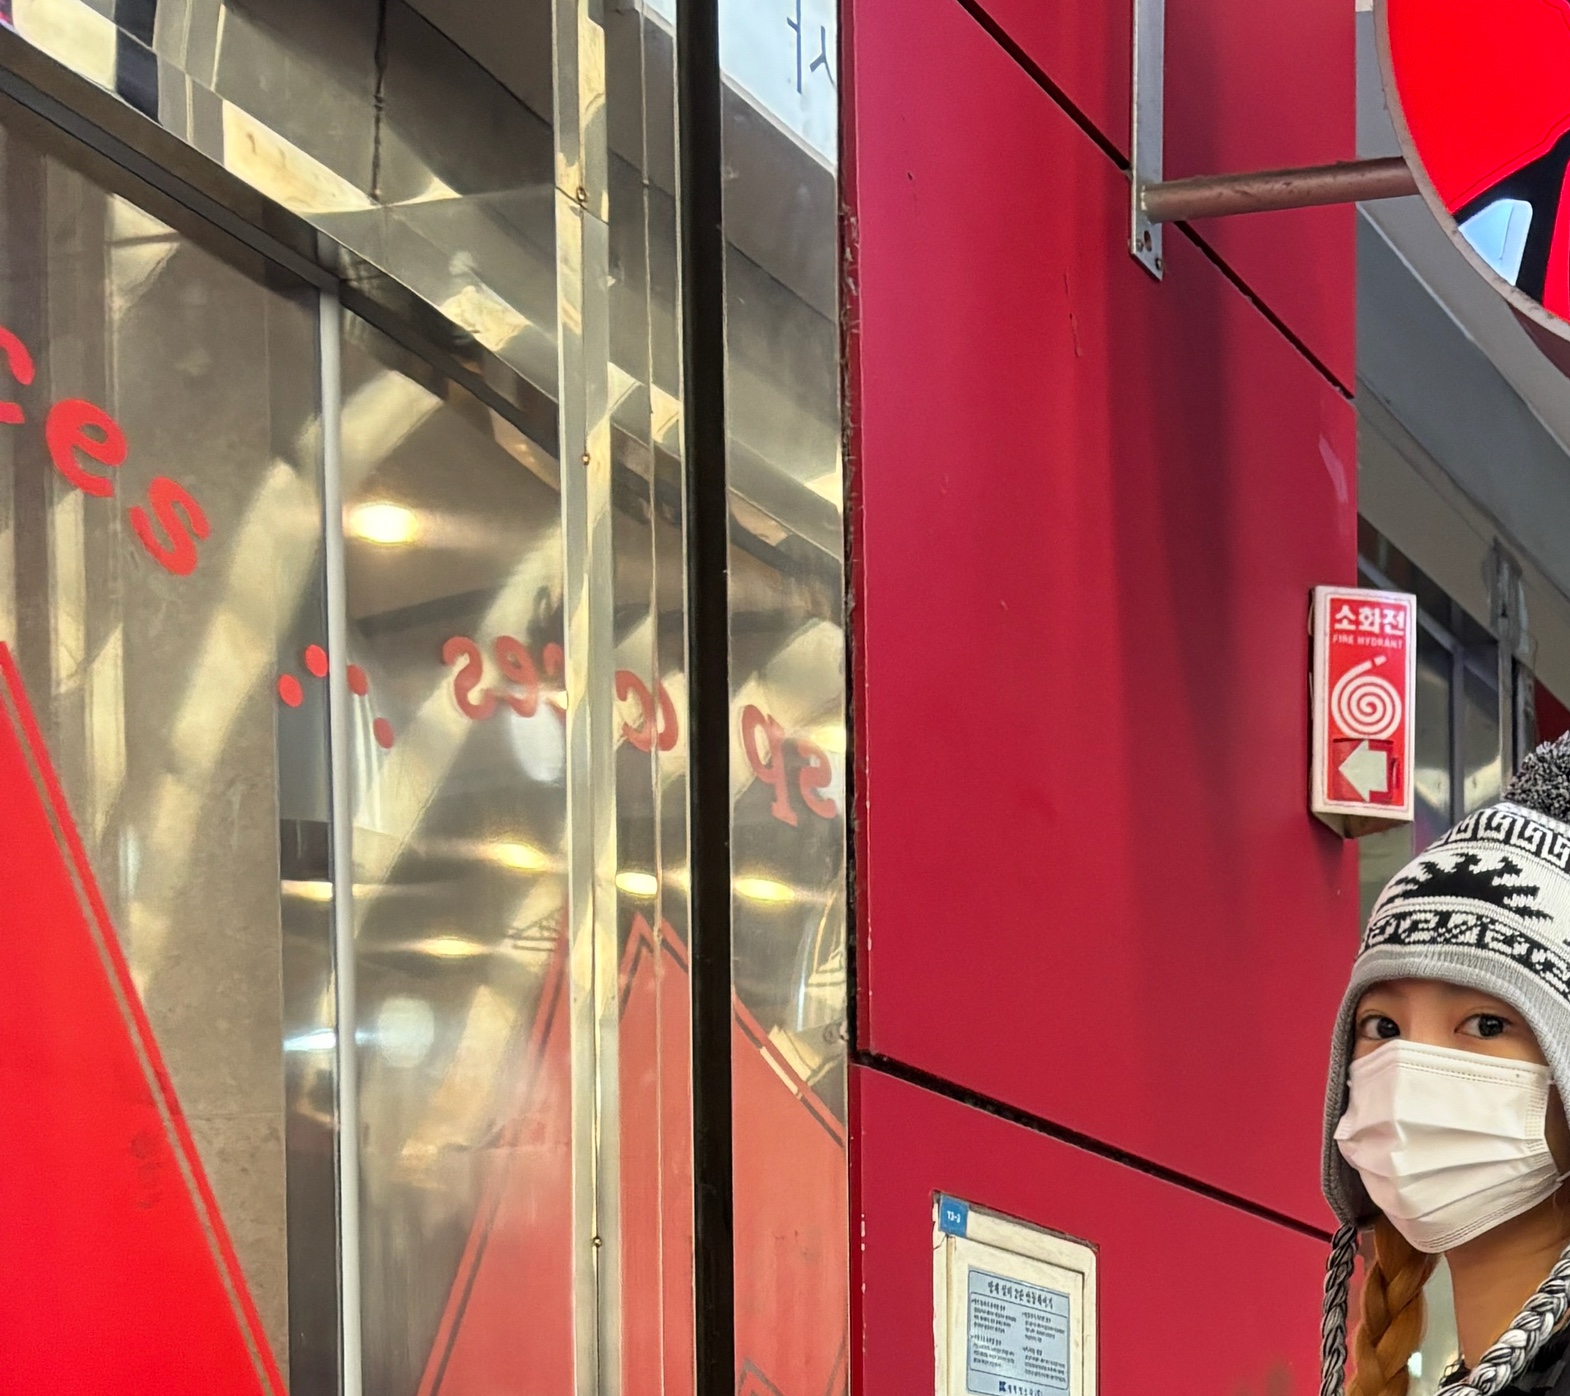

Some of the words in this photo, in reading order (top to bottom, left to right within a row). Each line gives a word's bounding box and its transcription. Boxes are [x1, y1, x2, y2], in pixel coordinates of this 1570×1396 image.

[1334, 605, 1404, 635] 소화전
[1333, 634, 1354, 645] FIRE
[1357, 637, 1403, 650] HYDRANT
